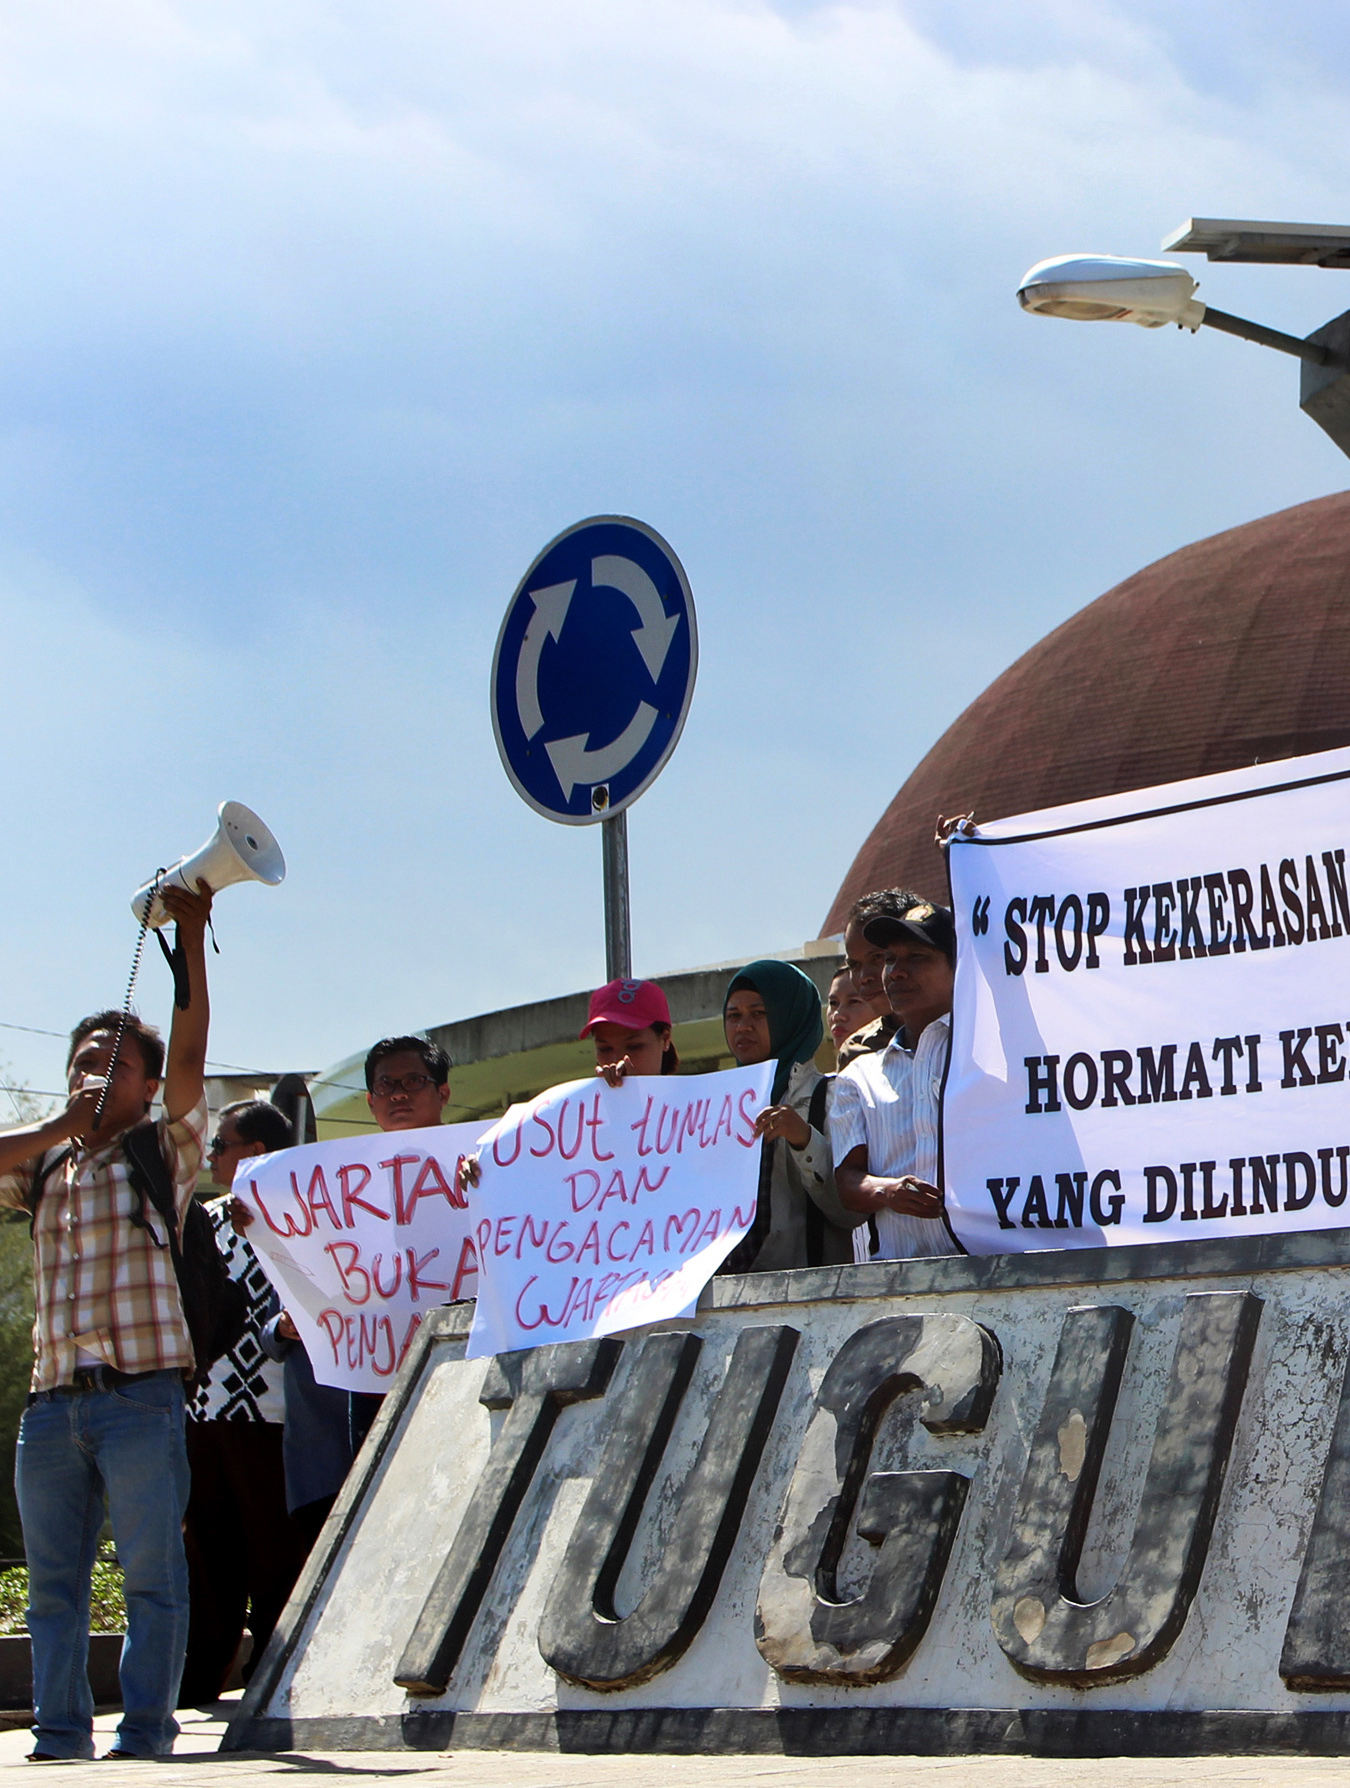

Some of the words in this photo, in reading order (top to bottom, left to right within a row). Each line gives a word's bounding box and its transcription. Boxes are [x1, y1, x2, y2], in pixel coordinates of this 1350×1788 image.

[1003, 893, 1110, 976] STOP
[1024, 1034, 1262, 1114] HORMATI
[563, 1164, 671, 1212] DAN
[986, 1168, 1126, 1230] YANG
[476, 1199, 757, 1276] PENGACAMAN
[394, 1290, 1263, 1698] TUGU
